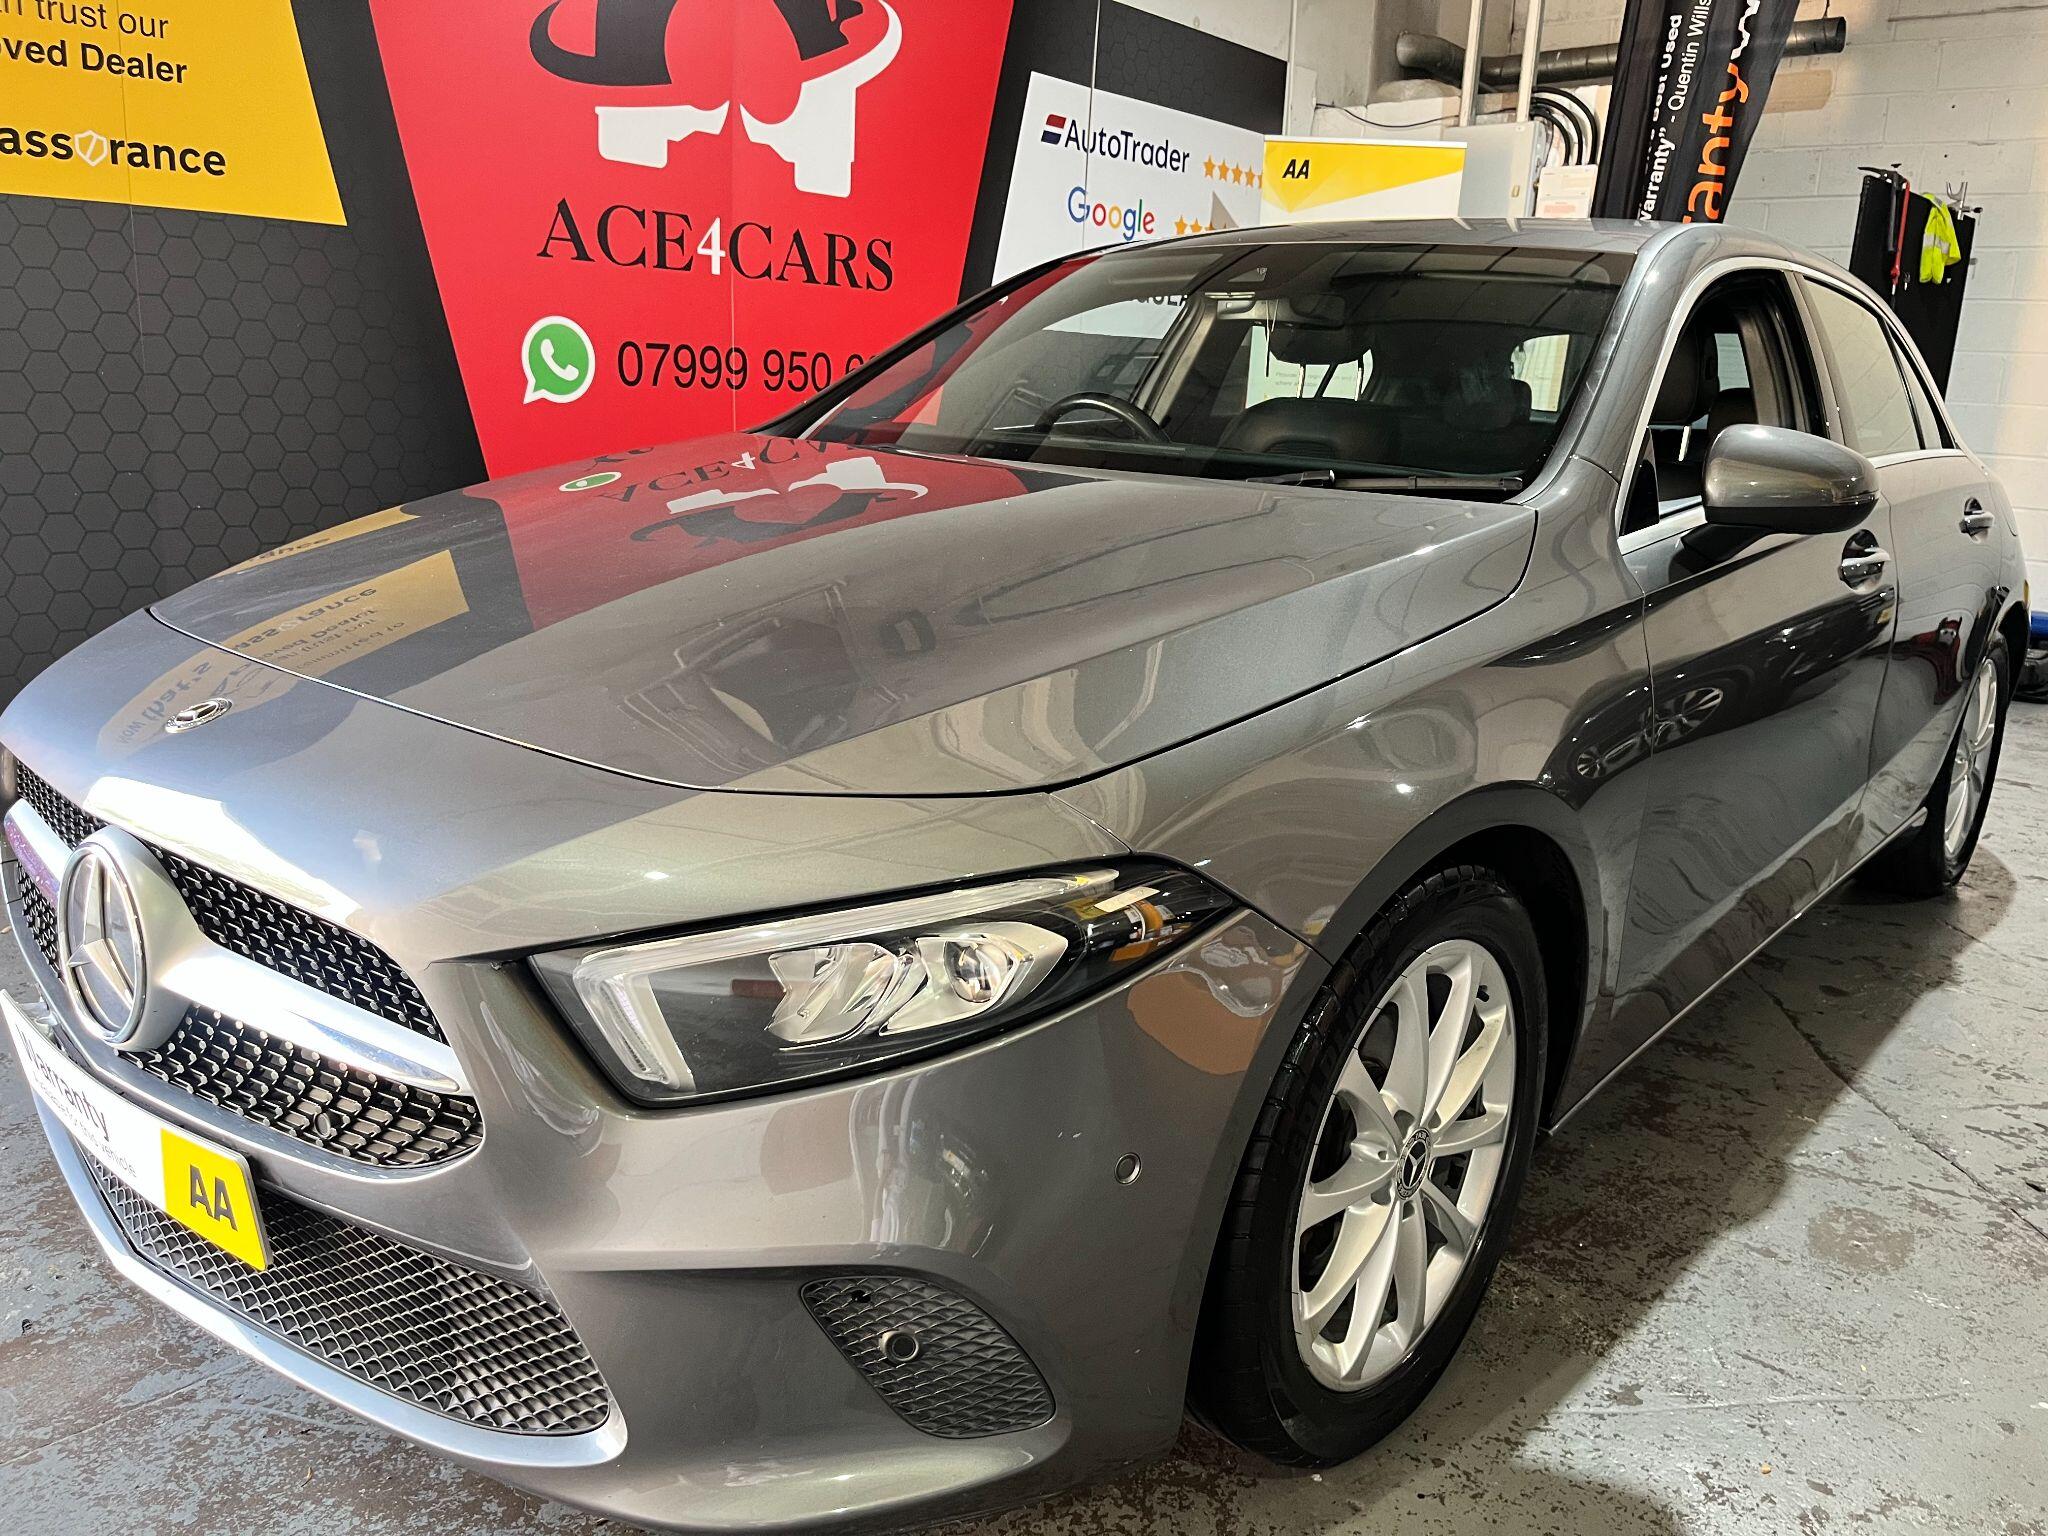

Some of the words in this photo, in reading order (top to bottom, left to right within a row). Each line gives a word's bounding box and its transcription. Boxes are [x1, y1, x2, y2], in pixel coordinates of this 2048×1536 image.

[35, 0, 107, 29] trust
[118, 12, 169, 39] our
[0, 37, 68, 68] ved
[81, 42, 188, 84] Dealer
[1668, 41, 1700, 111] Quentin
[1064, 119, 1190, 173] AutoTrader
[1282, 159, 1310, 180] AA
[1067, 186, 1155, 242] Google
[537, 197, 893, 292] ACE4CARS
[618, 341, 748, 391] 07999
[763, 350, 832, 393] 950
[189, 1164, 239, 1232] AA
